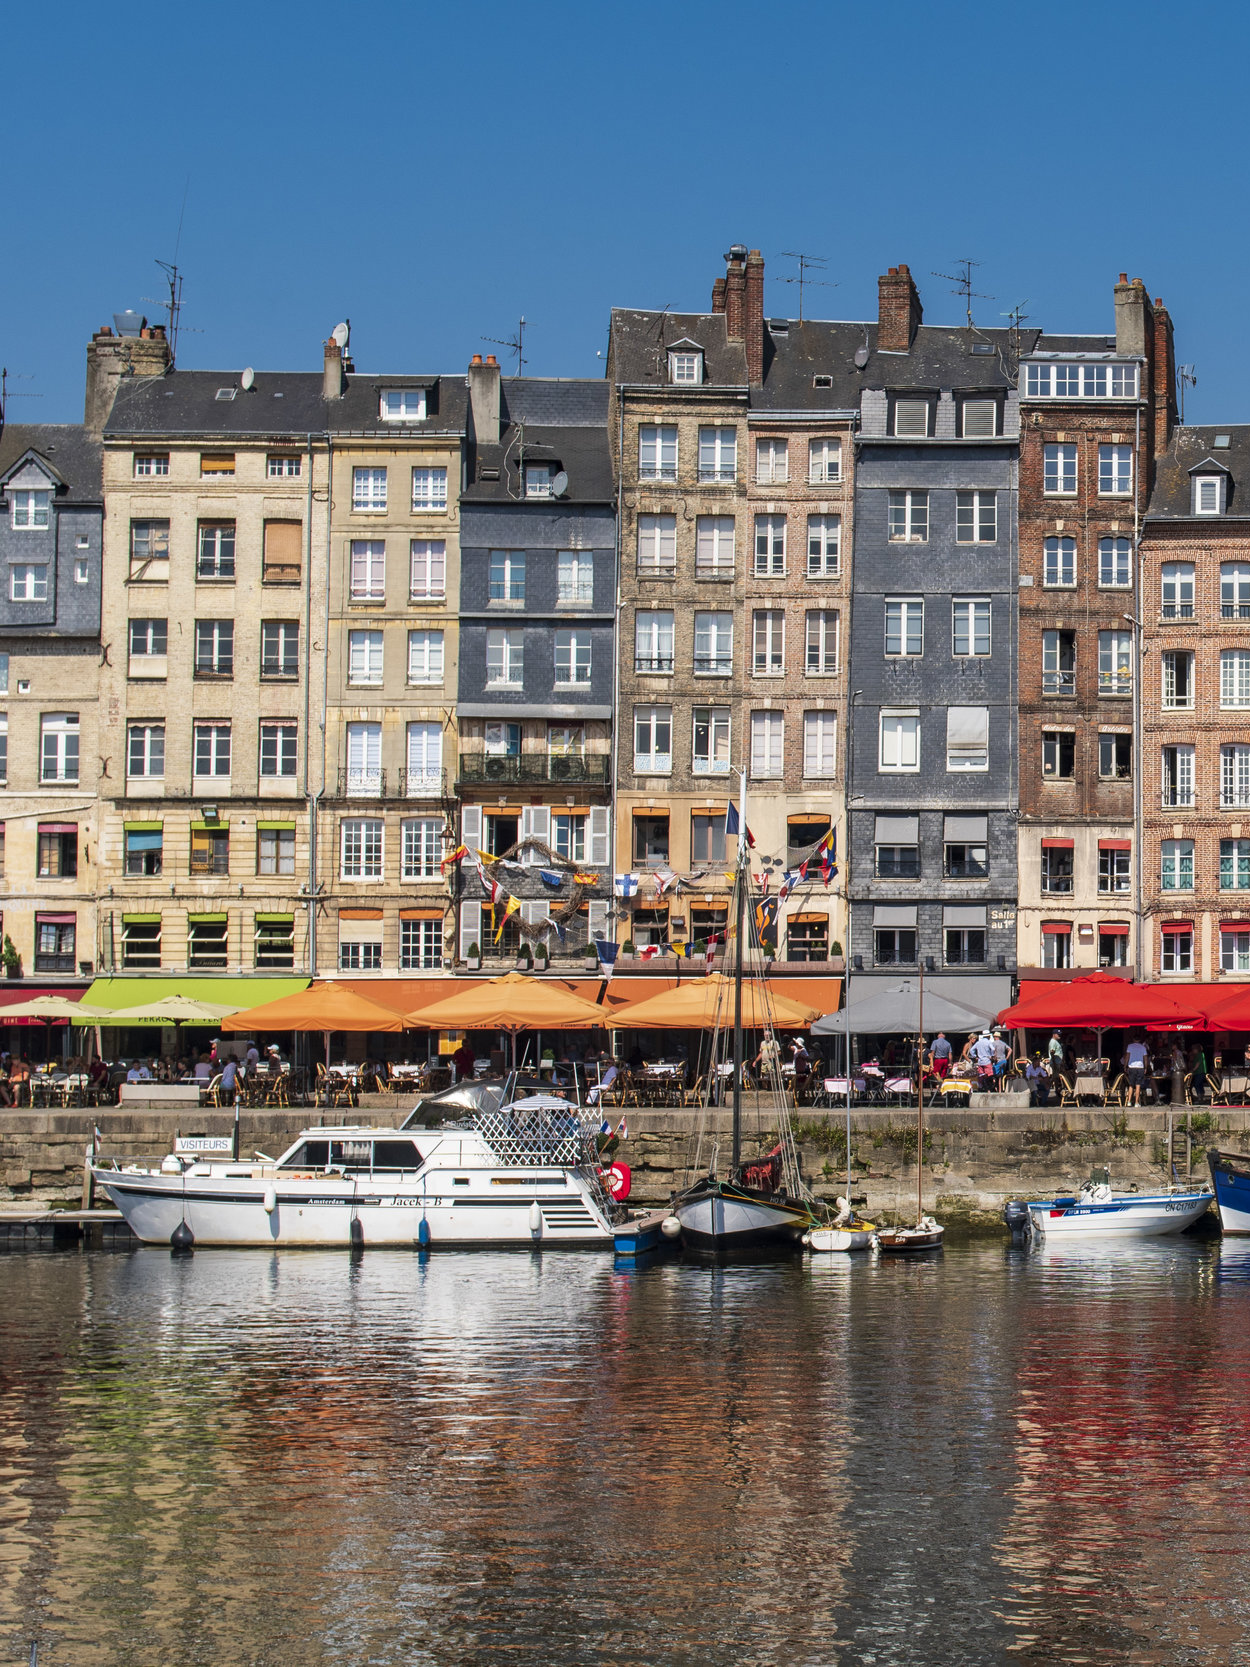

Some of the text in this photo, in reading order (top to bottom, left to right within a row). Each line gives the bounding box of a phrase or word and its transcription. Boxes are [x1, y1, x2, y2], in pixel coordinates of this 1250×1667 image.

[991, 910, 1015, 919] Salle
[181, 1140, 228, 1149] VISITEURS
[390, 1196, 422, 1206] Jacek
[434, 1197, 442, 1206] B
[1165, 1203, 1175, 1212] CN
